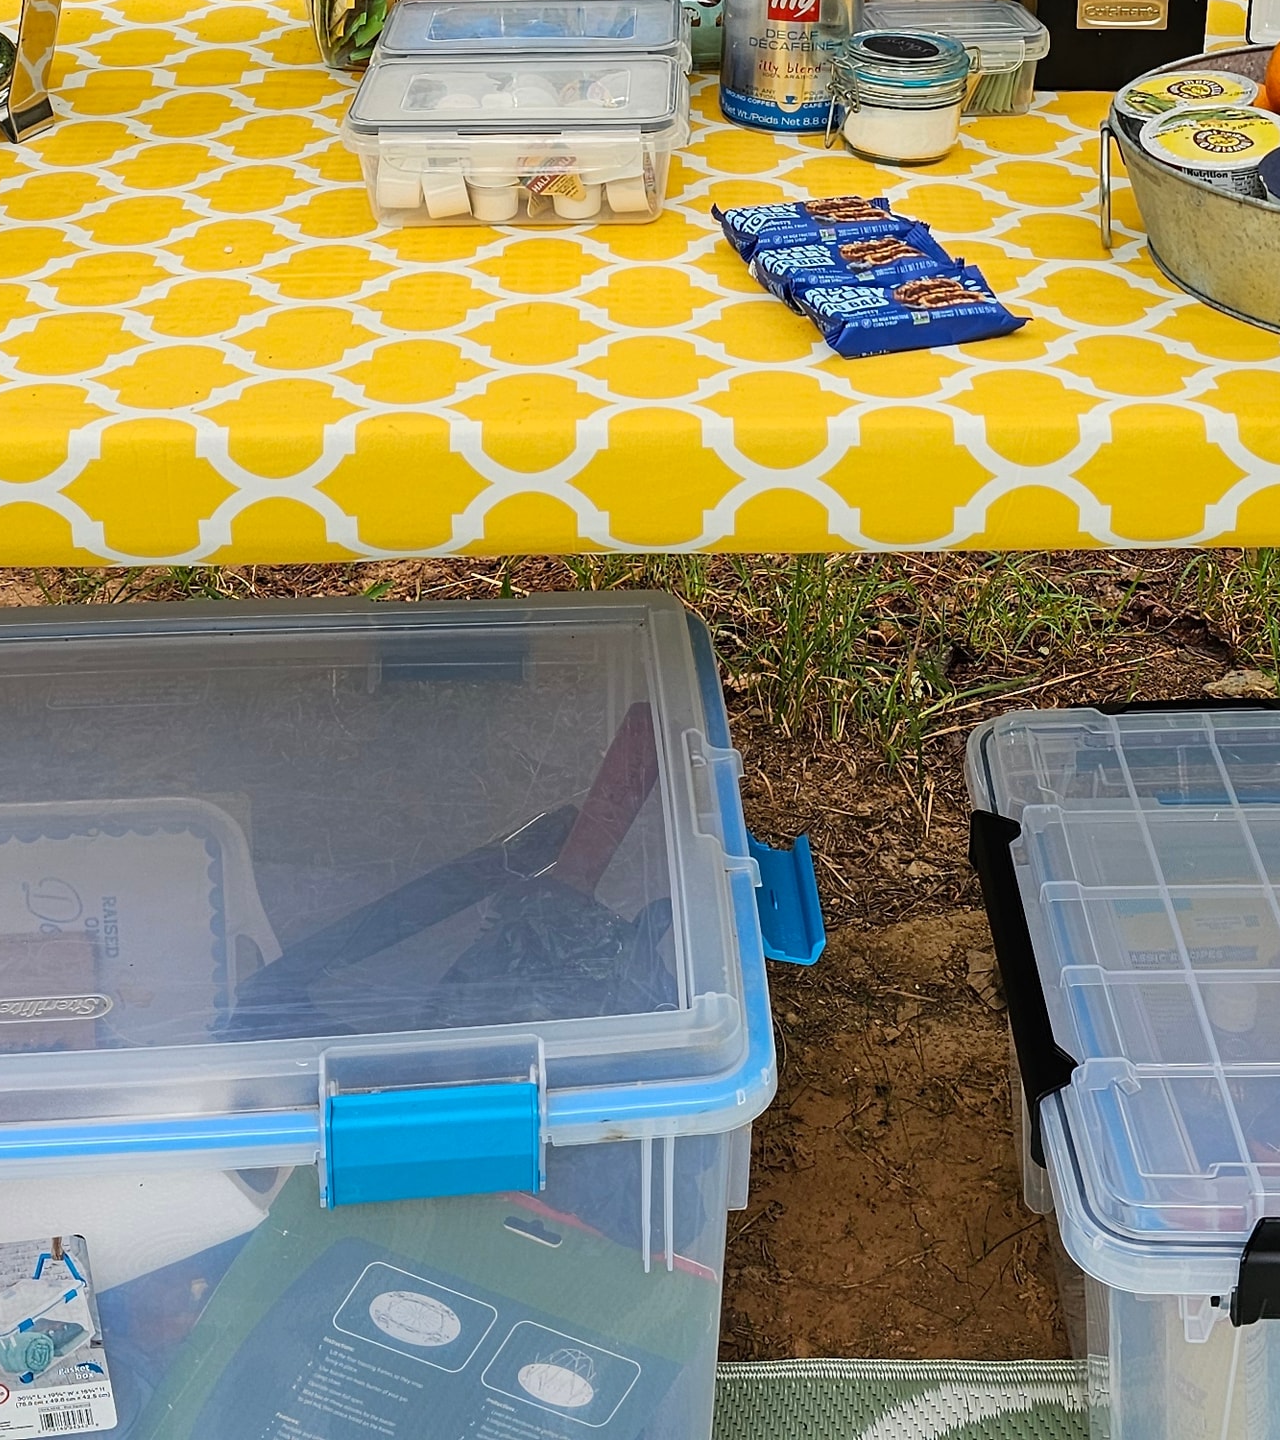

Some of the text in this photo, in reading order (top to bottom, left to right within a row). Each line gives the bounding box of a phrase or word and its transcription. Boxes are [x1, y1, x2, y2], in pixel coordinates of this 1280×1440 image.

[1085, 6, 1160, 17] Cuisinart
[766, 29, 818, 41] DECAF
[758, 60, 779, 74] illy
[747, 97, 776, 108] COFFEE
[781, 116, 801, 126] Net
[803, 117, 819, 126] 8.8
[1186, 169, 1228, 178] Nutrition
[849, 297, 883, 308] BAR
[102, 895, 118, 958] RAISED
[58, 1365, 91, 1376] gasket
[75, 1371, 95, 1380] box
